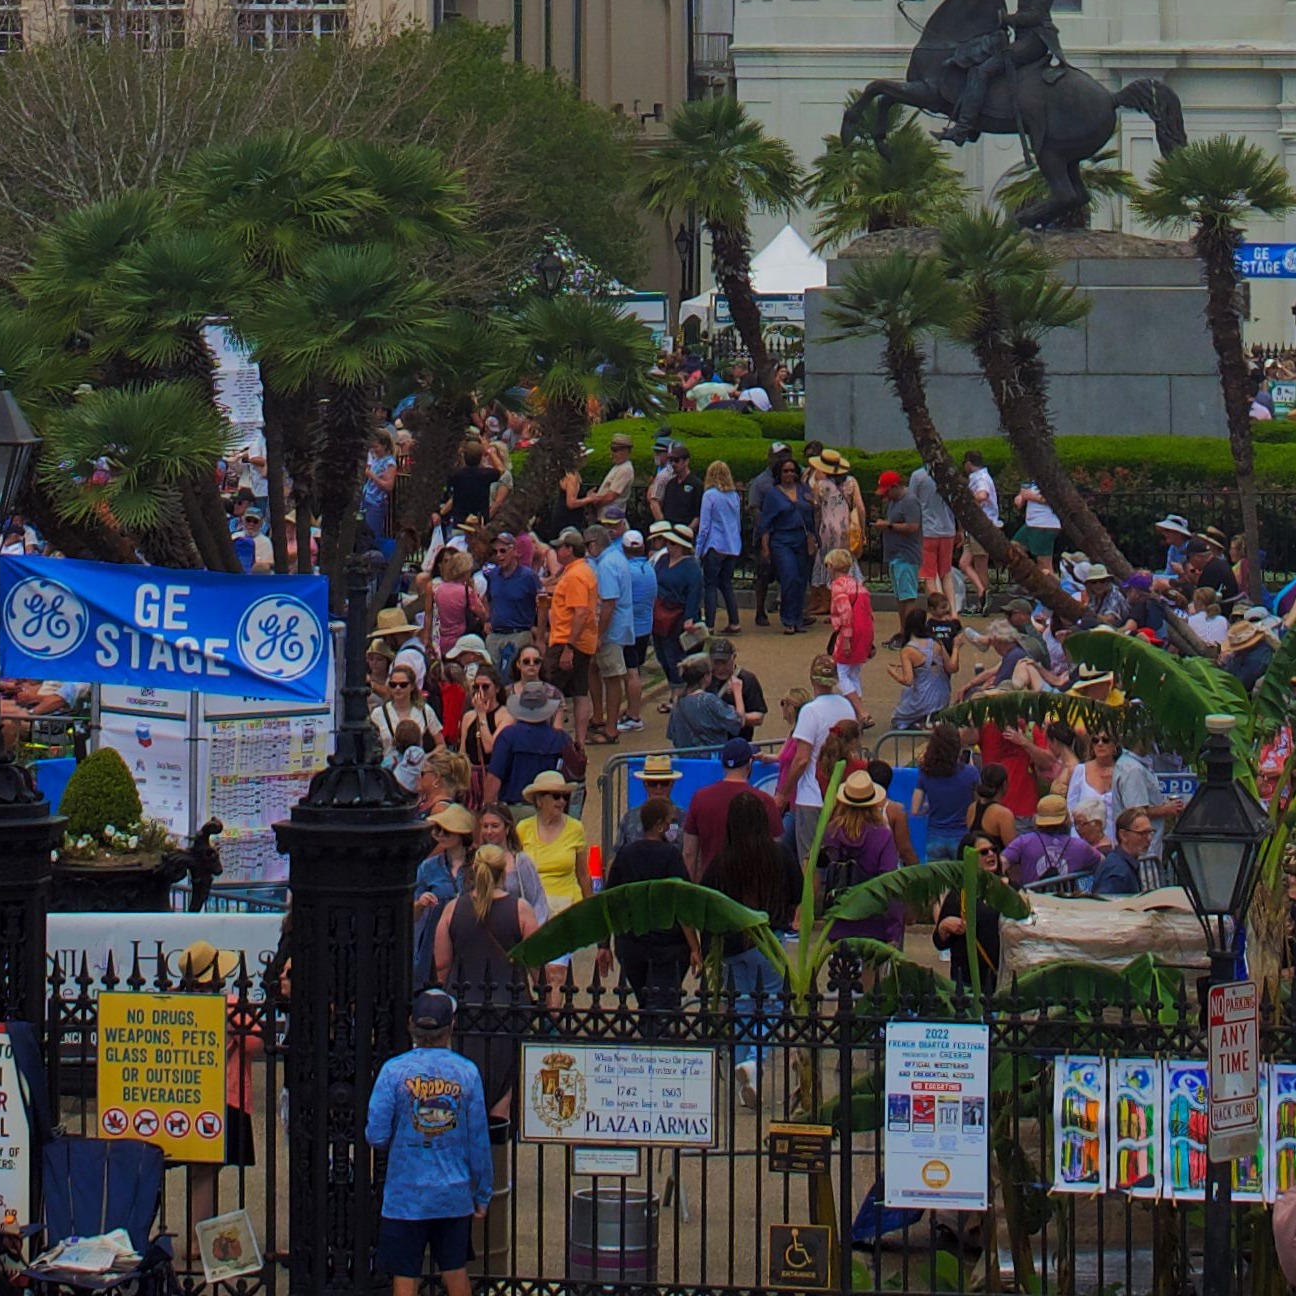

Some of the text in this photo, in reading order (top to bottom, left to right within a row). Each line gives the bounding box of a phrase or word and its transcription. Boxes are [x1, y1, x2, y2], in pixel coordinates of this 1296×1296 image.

[1254, 246, 1270, 260] GE
[1242, 260, 1281, 274] STAGE
[134, 583, 190, 630] GE
[95, 622, 231, 677] STAGE
[1210, 993, 1254, 1018] NO PARKING
[127, 1009, 197, 1028] NO DRUGS,
[105, 1027, 174, 1047] WEAPONS,
[182, 1030, 220, 1048] PETS,
[925, 1028, 949, 1039] 2022
[1220, 1023, 1248, 1049] ANY
[105, 1047, 218, 1068] GLASS BOTTLES,
[1218, 1050, 1250, 1075] TIME
[122, 1067, 202, 1085] OR OUTSIDE
[122, 1086, 202, 1104] BEVERAGES
[585, 1111, 640, 1133] PLAZA
[654, 1114, 708, 1135] ARMAS
[9, 1146, 21, 1157] OF
